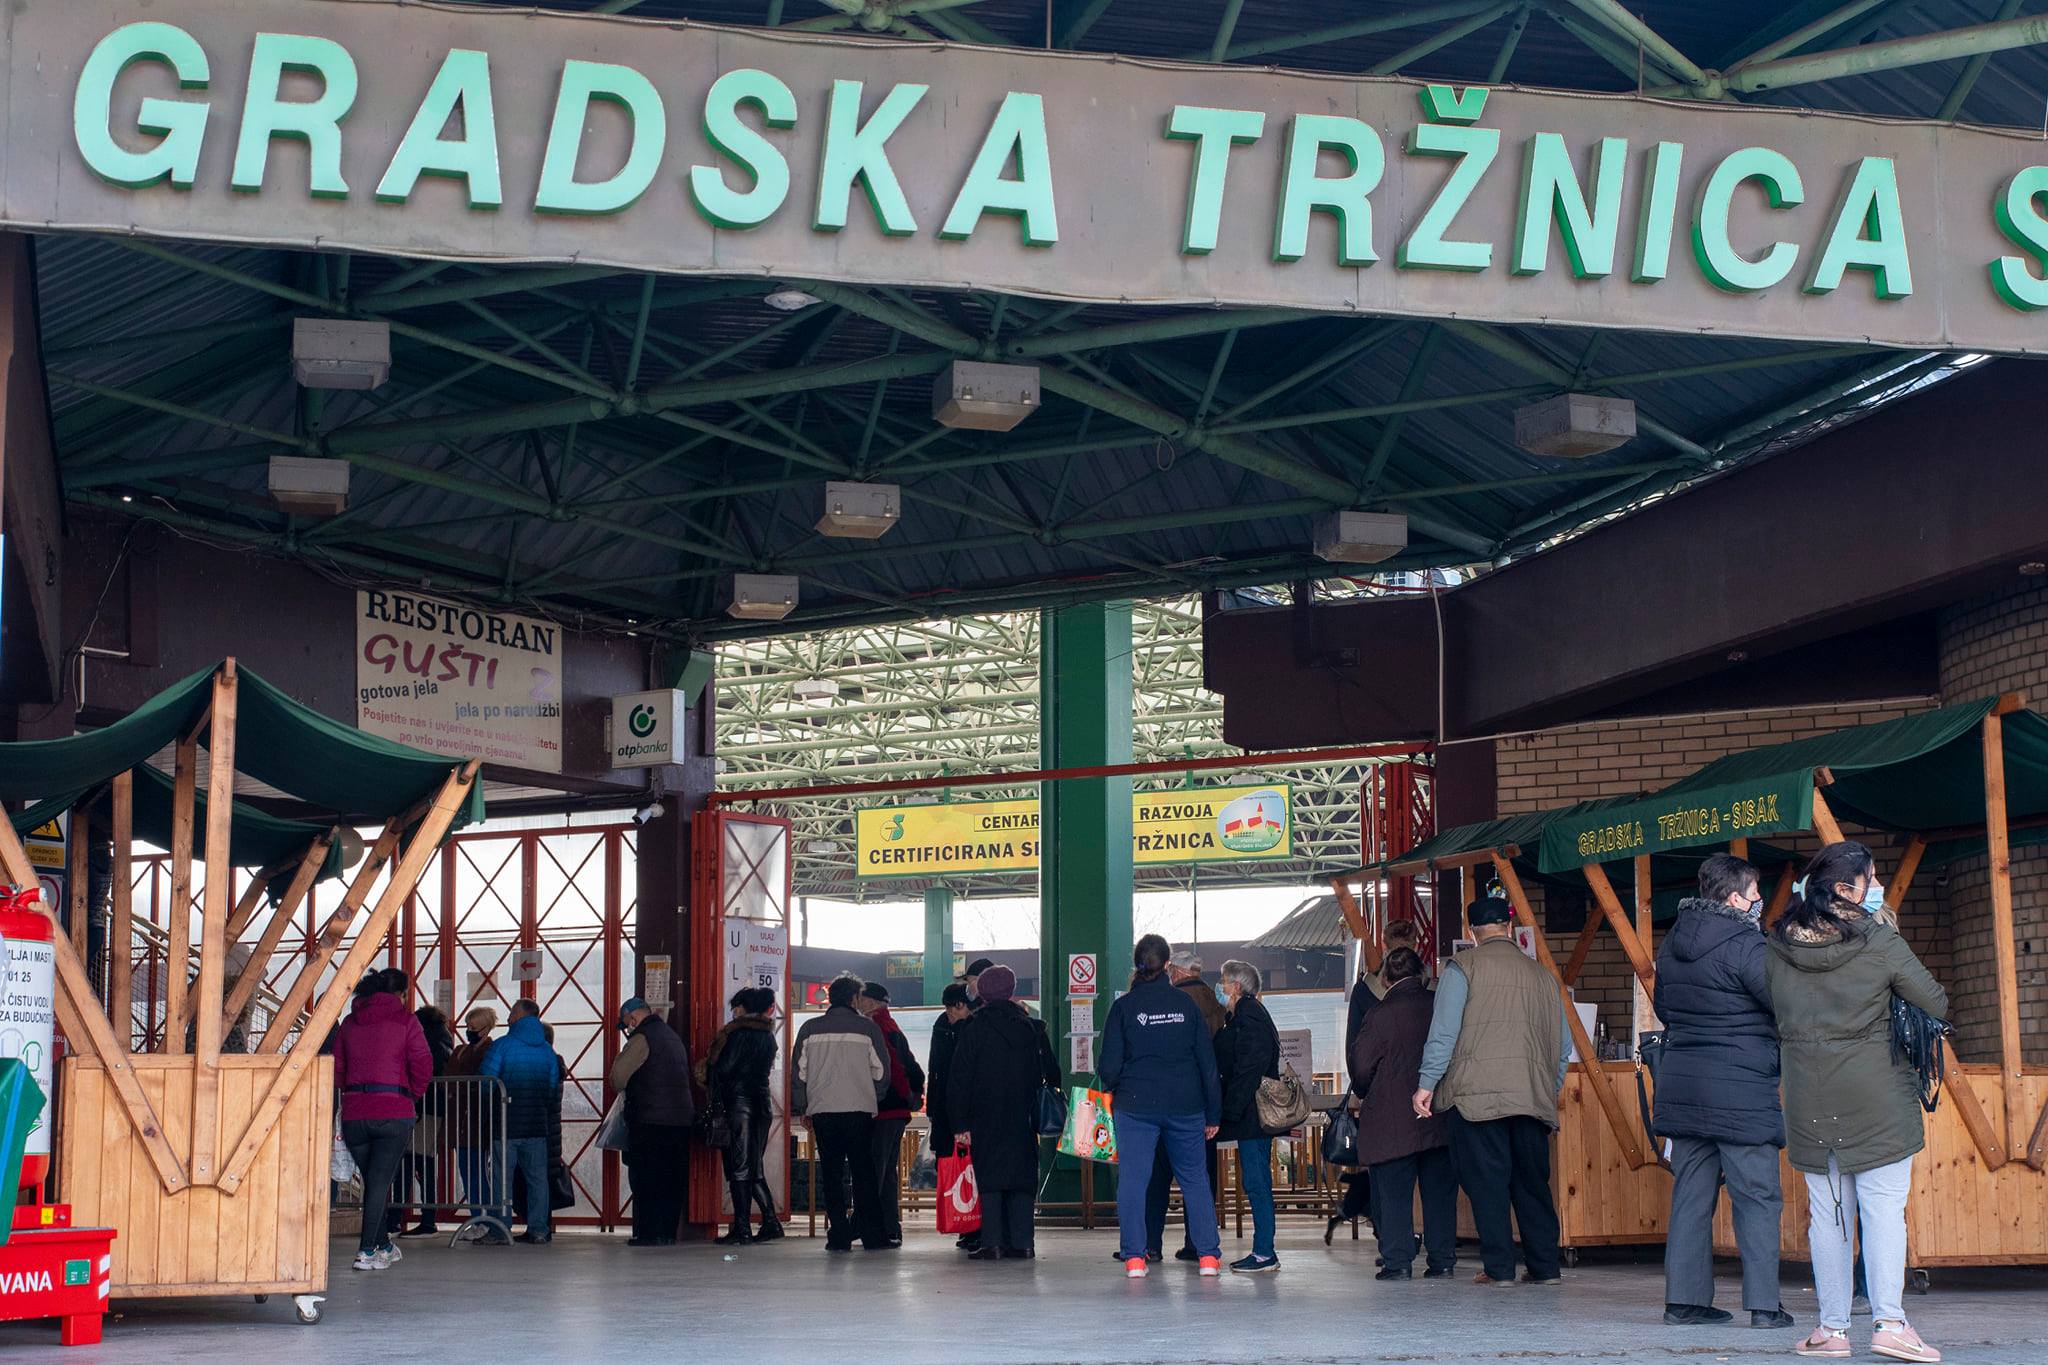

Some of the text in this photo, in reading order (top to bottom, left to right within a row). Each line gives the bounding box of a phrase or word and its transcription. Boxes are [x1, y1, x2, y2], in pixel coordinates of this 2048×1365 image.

[73, 21, 1058, 247] GRADSKA
[1165, 84, 1913, 301] TRŽNICA
[365, 590, 555, 655] RESTORAN
[363, 633, 499, 690] GUŠTI
[360, 680, 439, 703] gotova jela
[455, 702, 560, 720] jela po narudžbi
[363, 707, 407, 726] Posjetite
[409, 718, 427, 728] nas
[435, 720, 472, 737] uvjerite
[399, 732, 412, 744] po
[414, 734, 434, 746] vrlo
[436, 738, 483, 754] povoljnim
[981, 813, 1039, 829] CENTAR
[1140, 804, 1213, 820] RAZVOJA
[1133, 829, 1214, 851] RŽNICA
[1578, 821, 1644, 857] GRADSKA
[869, 843, 1014, 864] CERTIFICIRANA
[760, 931, 775, 941] ULAZ
[8, 950, 28, 962] LJA
[760, 945, 784, 956] TRŽNICU
[21, 971, 32, 983] 25
[758, 974, 773, 986] 50
[7, 994, 32, 1007] ČISTU
[0, 1010, 11, 1022] ZA
[0, 1270, 53, 1294] VANA
